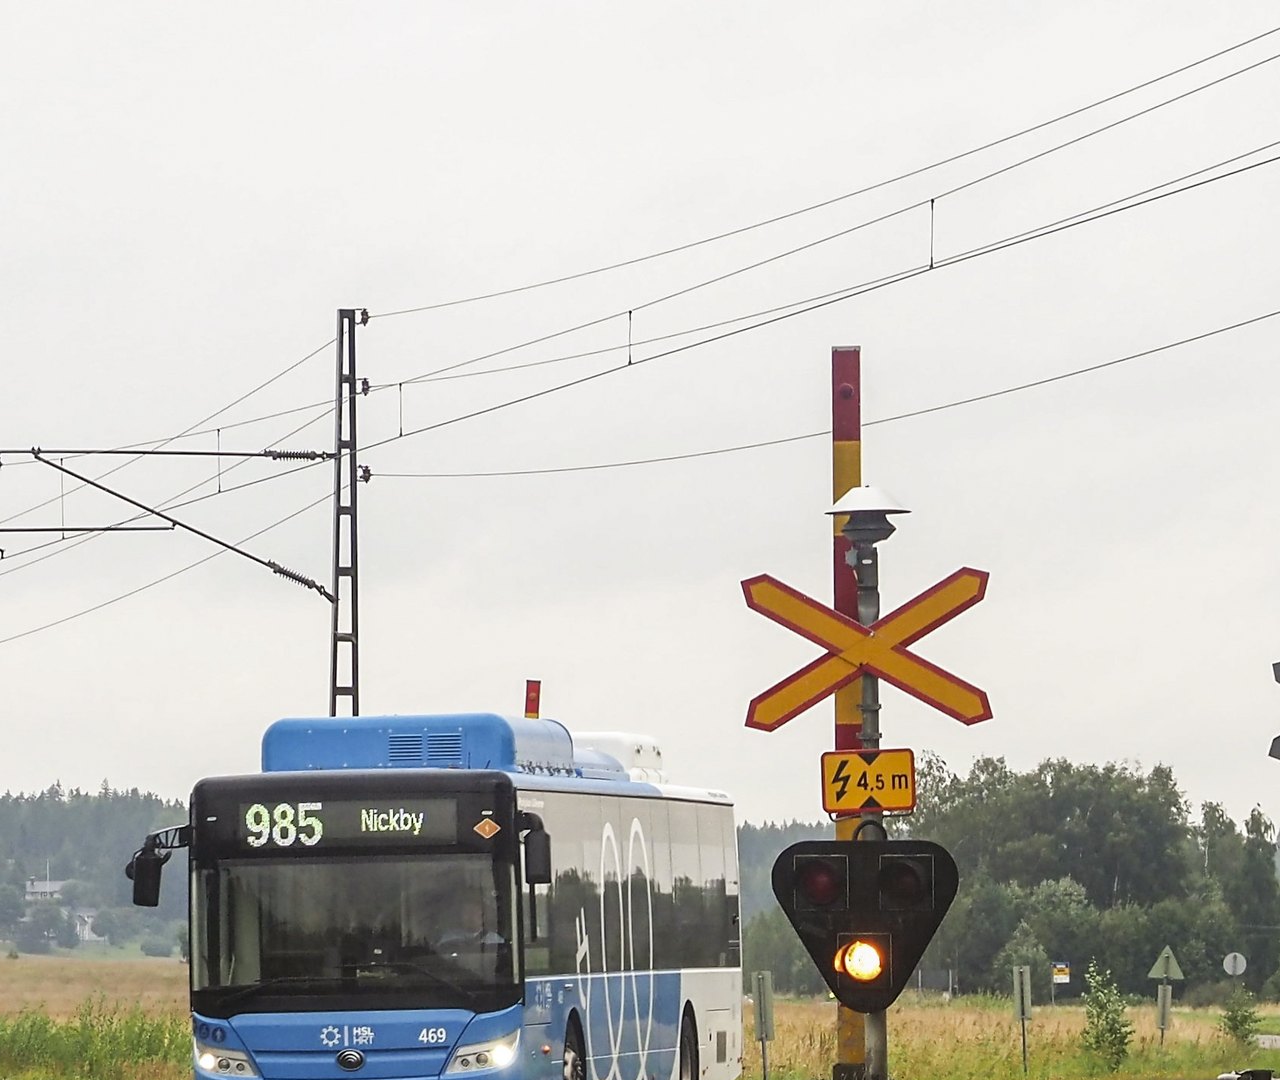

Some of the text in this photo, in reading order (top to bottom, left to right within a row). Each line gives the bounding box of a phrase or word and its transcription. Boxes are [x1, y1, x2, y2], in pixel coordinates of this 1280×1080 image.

[857, 770, 909, 792] 4,5 m
[245, 802, 423, 847] 985 Nickby
[353, 1026, 374, 1036] HSL
[418, 1028, 446, 1043] 469
